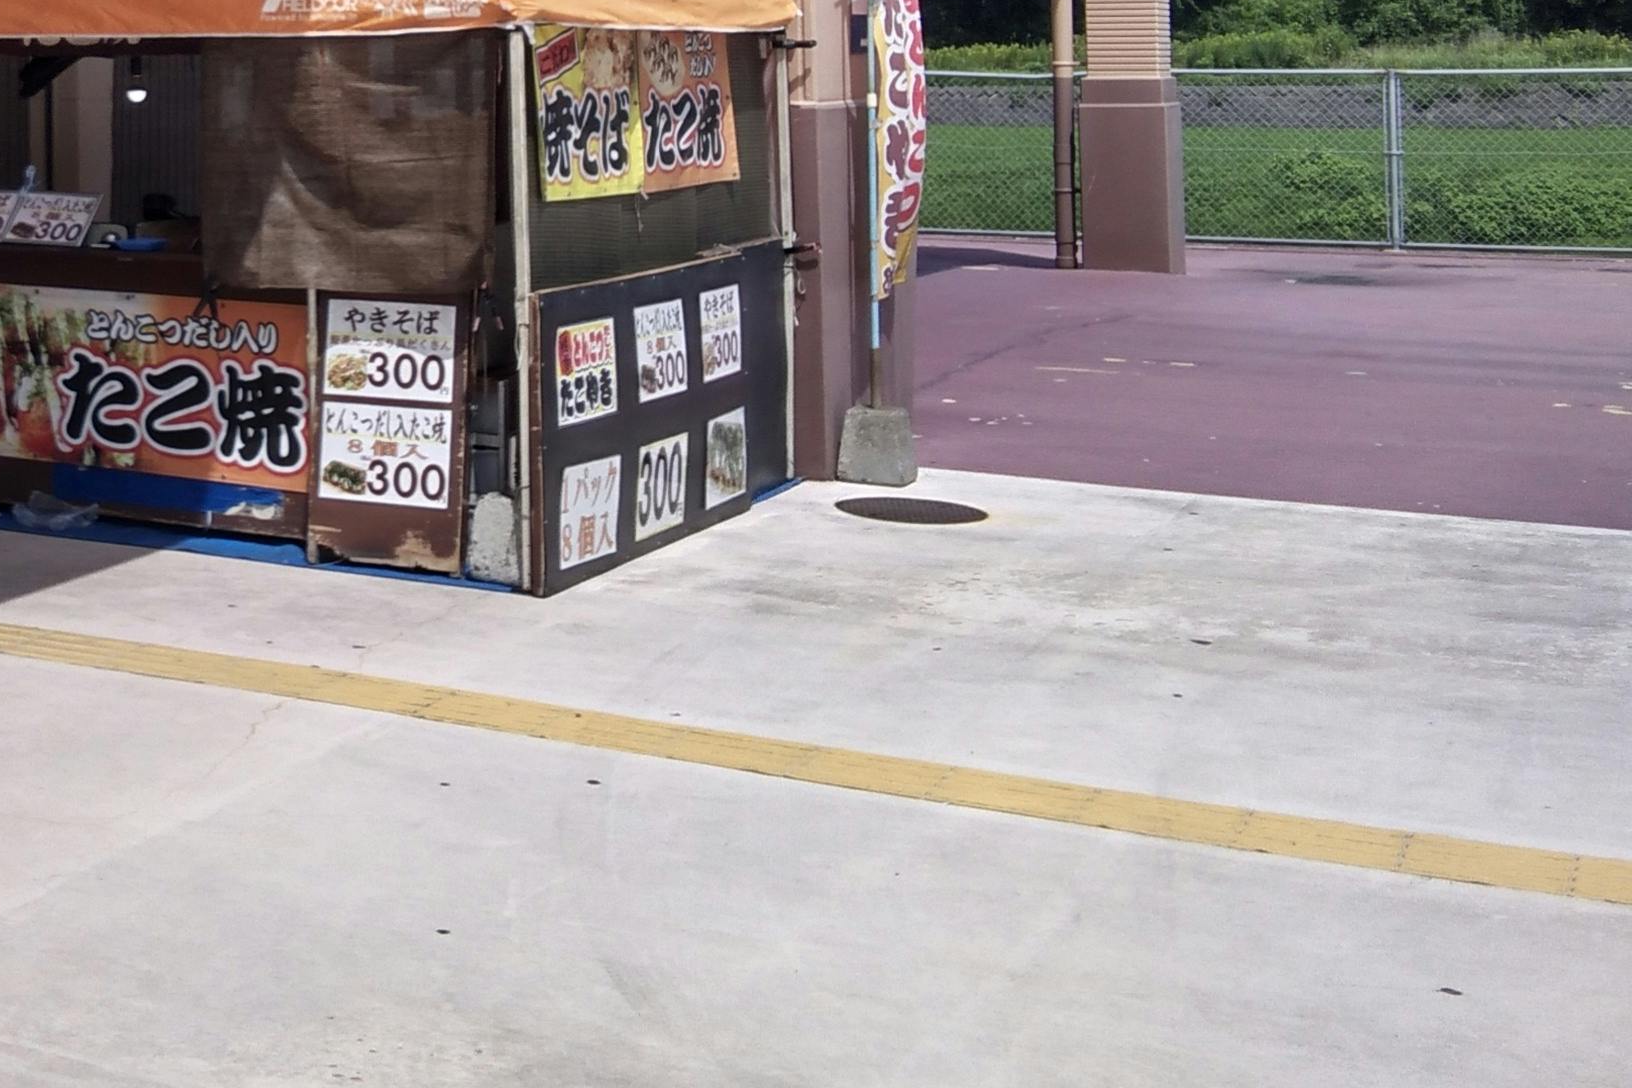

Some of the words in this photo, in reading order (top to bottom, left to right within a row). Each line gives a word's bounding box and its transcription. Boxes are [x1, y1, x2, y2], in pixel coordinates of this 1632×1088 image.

[542, 89, 630, 180] 焼そば
[644, 86, 724, 170] たこ焼
[86, 308, 280, 354] とんこつだし入り
[343, 306, 441, 335] やきそば
[58, 349, 307, 471] たこ焼
[346, 438, 428, 460] 8個入
